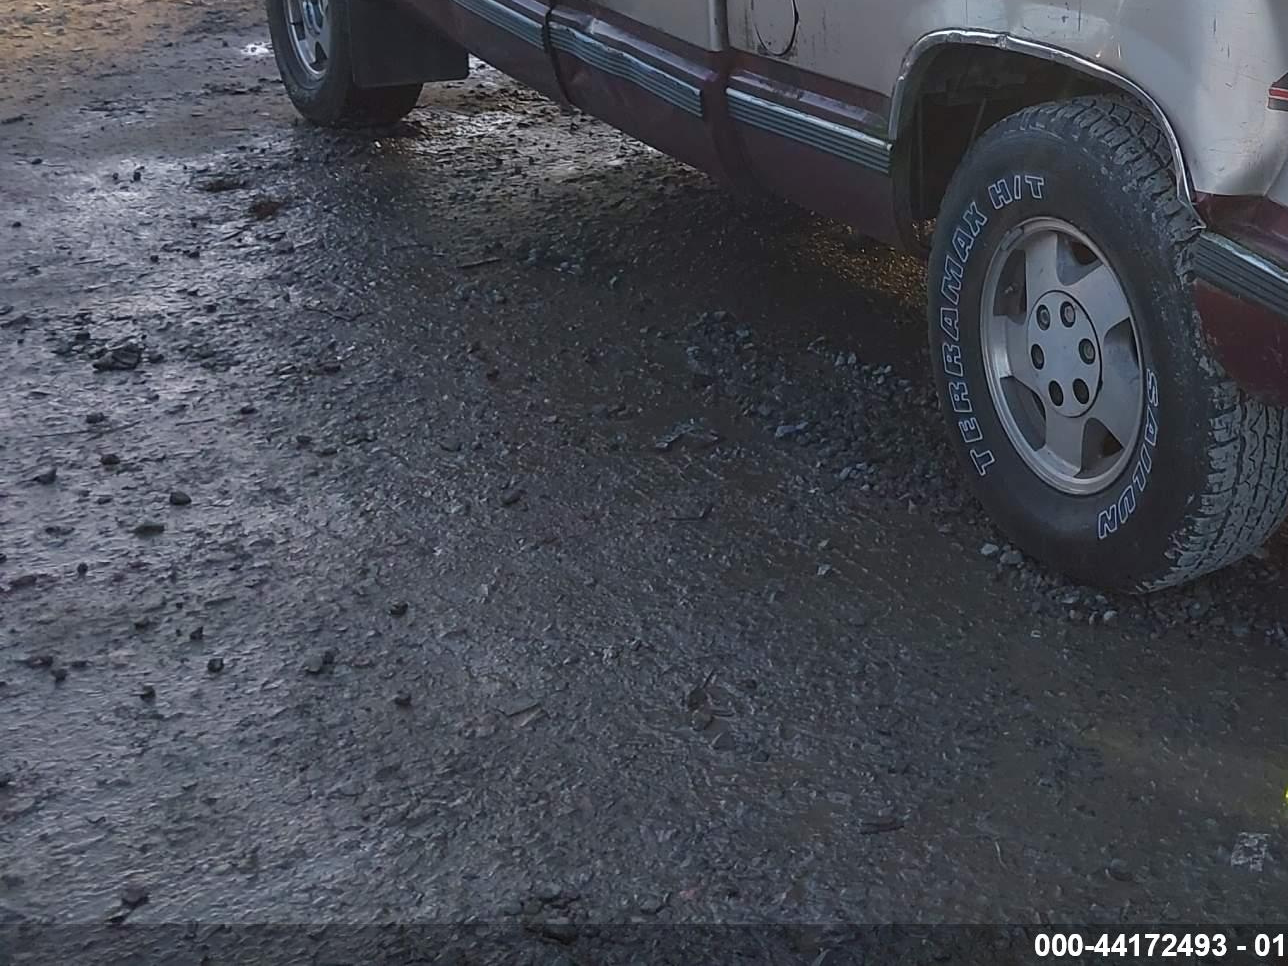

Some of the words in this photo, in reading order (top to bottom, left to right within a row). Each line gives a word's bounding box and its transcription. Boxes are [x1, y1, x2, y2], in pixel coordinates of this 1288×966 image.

[938, 200, 996, 476] TERRAMAX
[988, 174, 1045, 210] H/T
[1097, 368, 1160, 540] SAILUN
